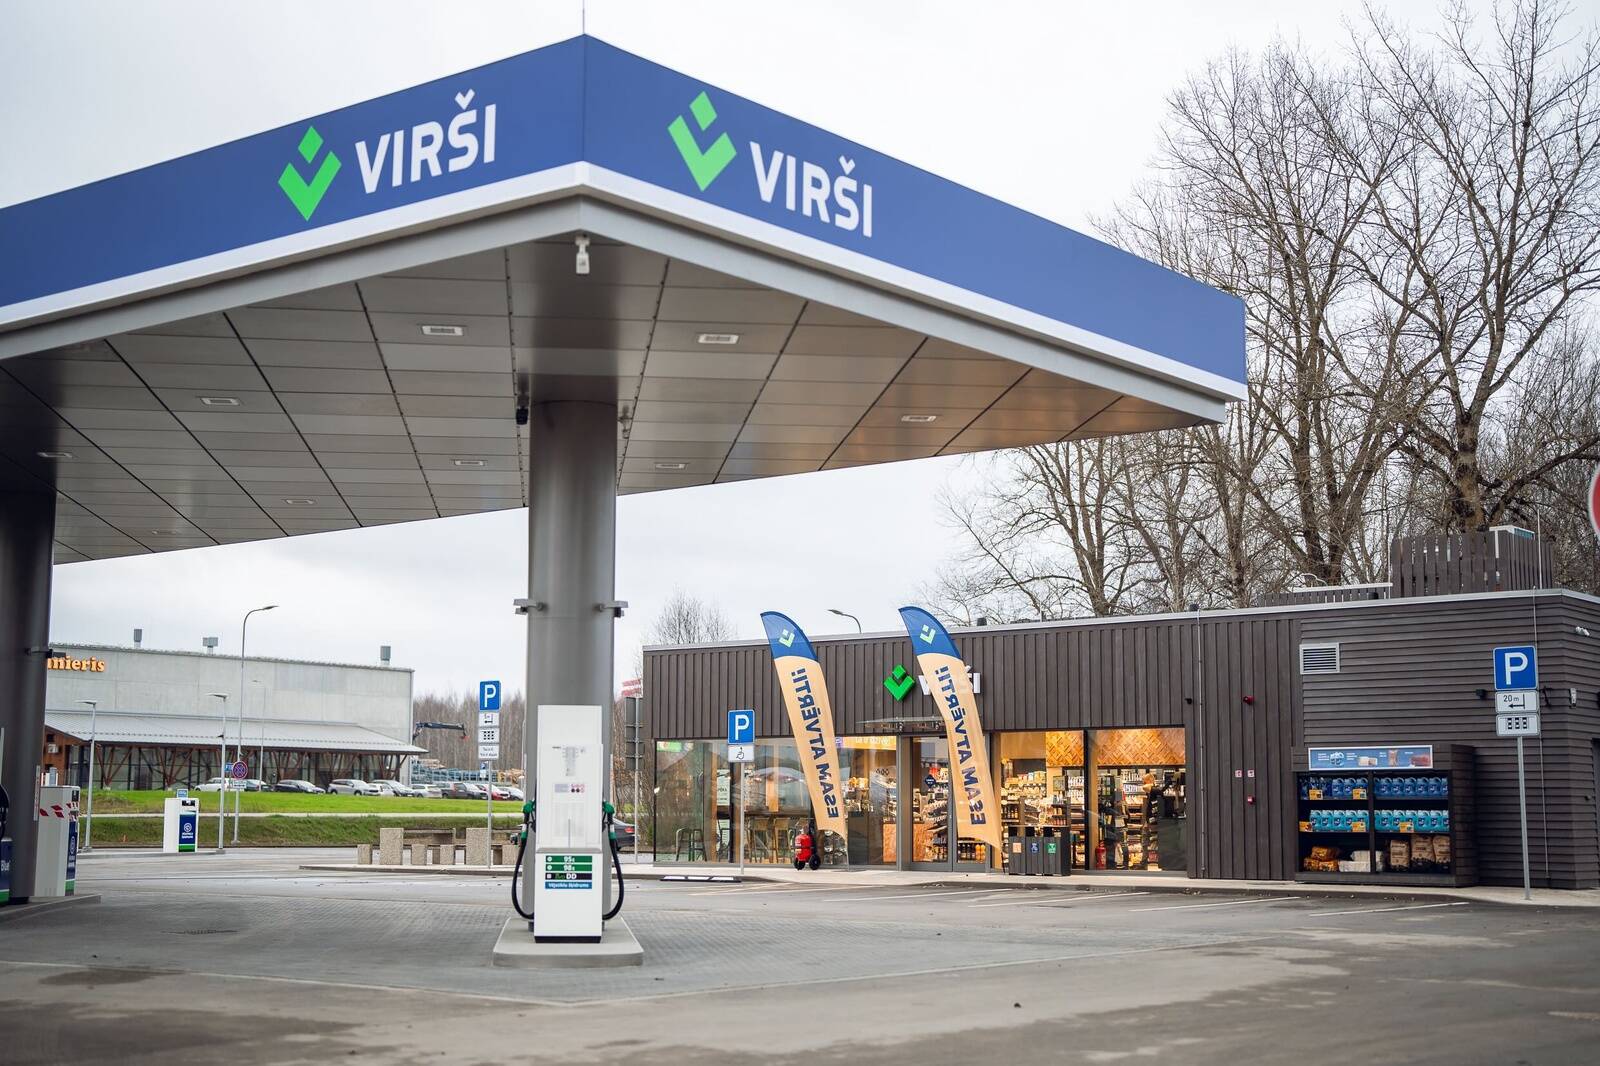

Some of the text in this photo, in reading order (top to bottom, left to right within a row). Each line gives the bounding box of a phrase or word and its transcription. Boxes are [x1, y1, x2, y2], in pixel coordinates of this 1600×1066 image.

[355, 88, 496, 194] VIRŠI
[749, 140, 872, 238] VIRŠI
[1504, 652, 1529, 685] P
[484, 684, 497, 708] P
[1503, 694, 1513, 703] 20
[734, 714, 750, 741] P
